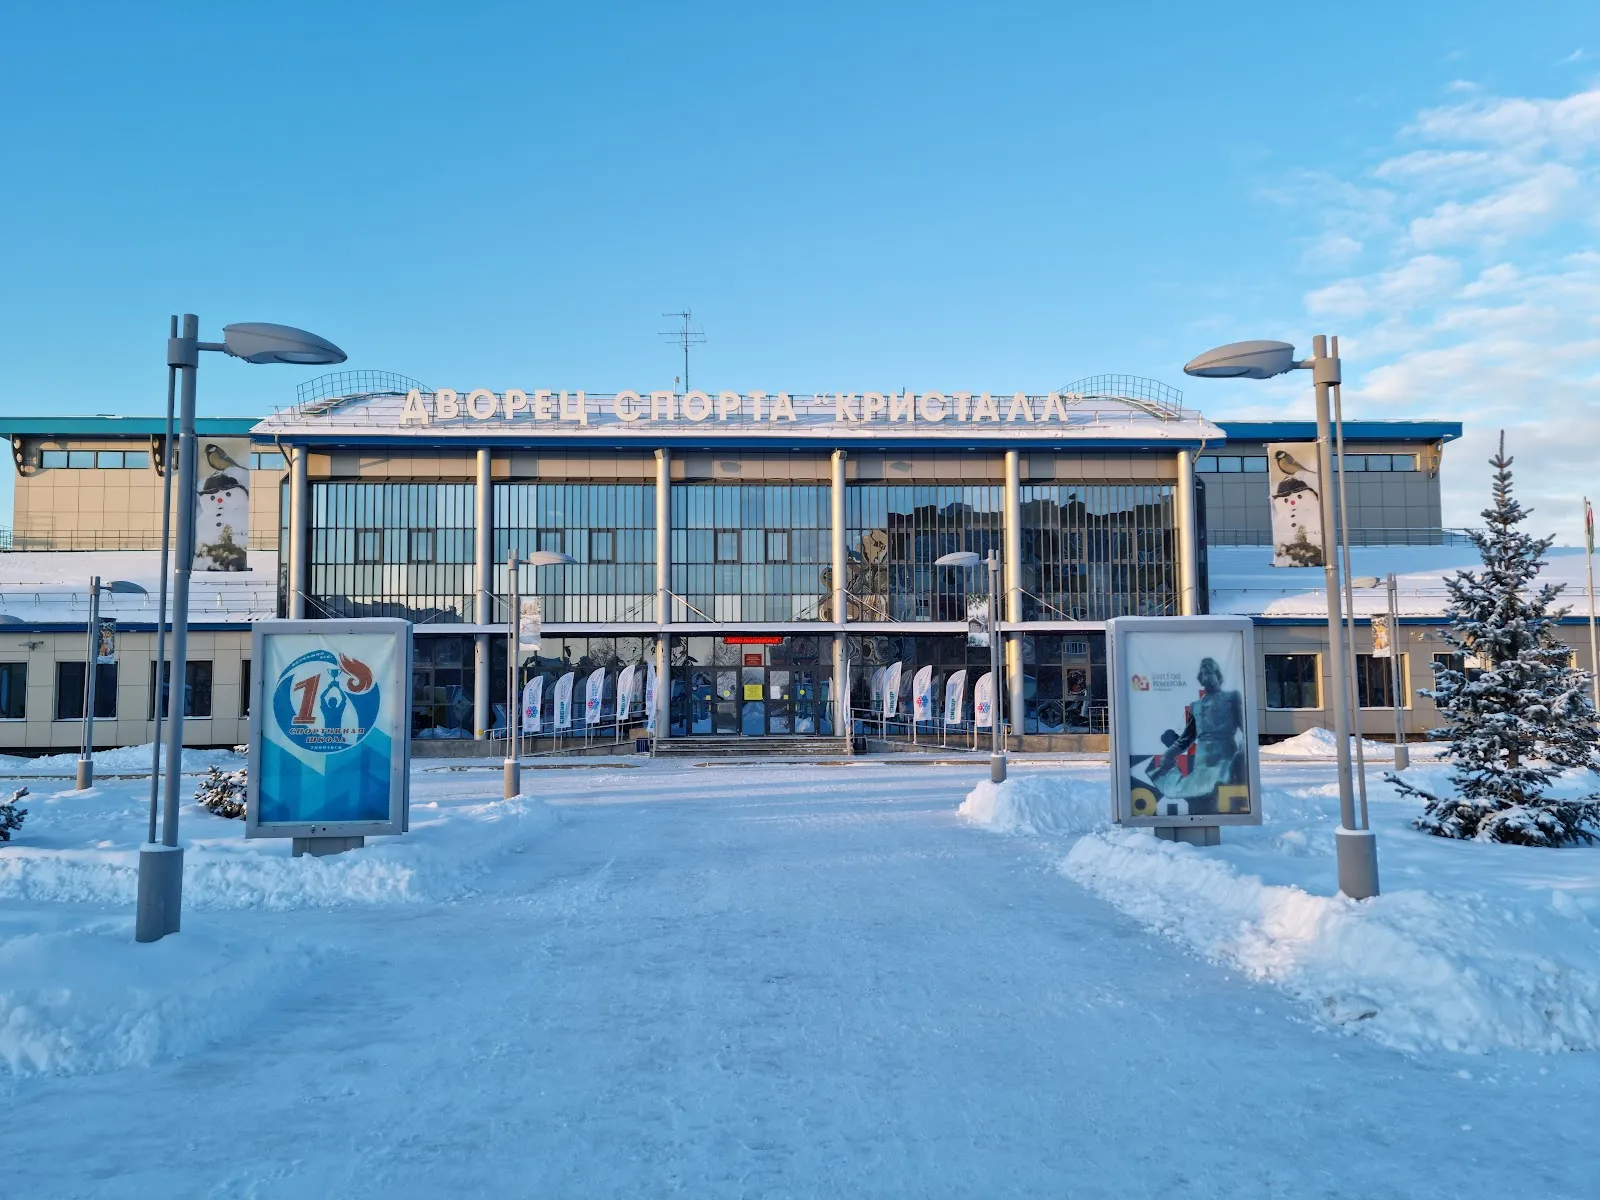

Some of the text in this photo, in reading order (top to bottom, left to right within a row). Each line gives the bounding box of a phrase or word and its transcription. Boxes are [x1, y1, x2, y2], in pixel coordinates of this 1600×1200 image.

[401, 388, 588, 426] ДВОРЕЦ
[613, 390, 797, 422] СПОРТА
[293, 673, 321, 724] 1
